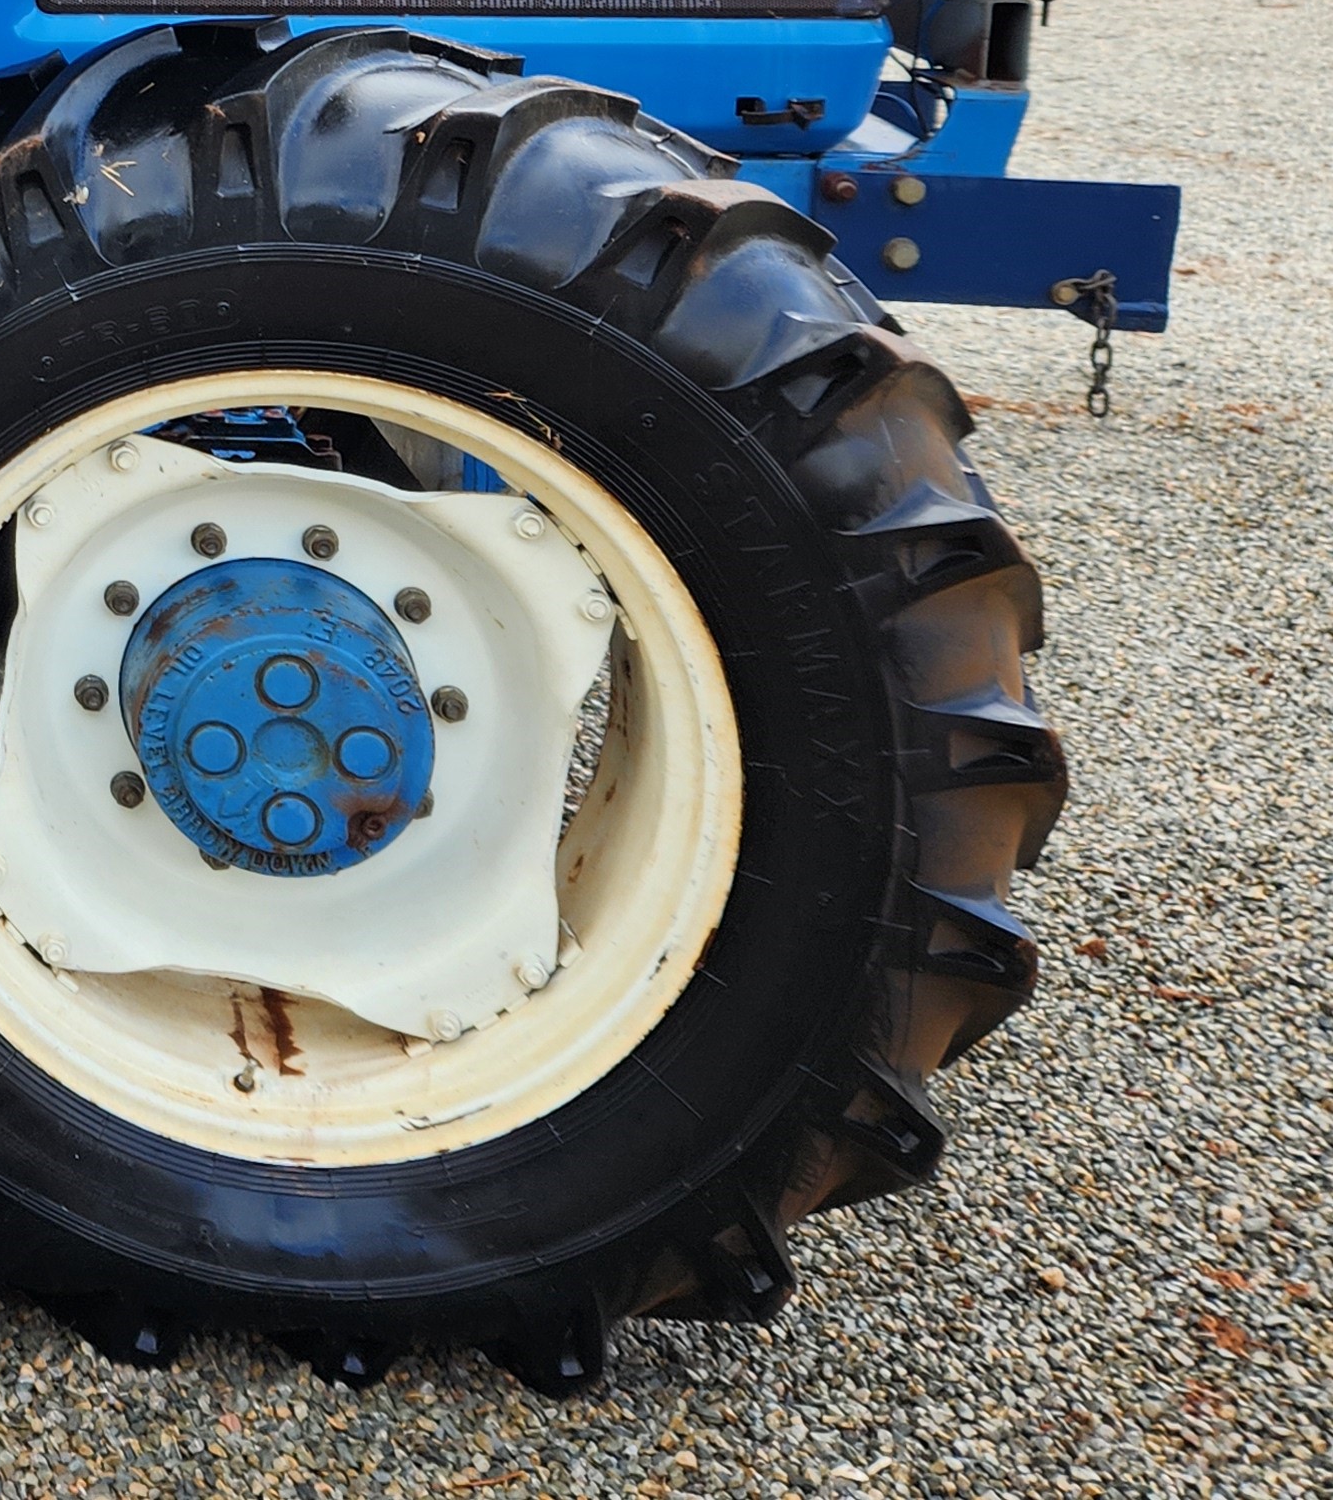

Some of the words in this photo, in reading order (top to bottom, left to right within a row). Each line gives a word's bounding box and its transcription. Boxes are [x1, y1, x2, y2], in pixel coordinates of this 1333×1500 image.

[162, 643, 203, 677] OIL
[693, 460, 863, 826] STARMAXX
[144, 688, 175, 779] LEVEL
[161, 784, 245, 867] ARROW
[249, 849, 332, 875] DOWN
